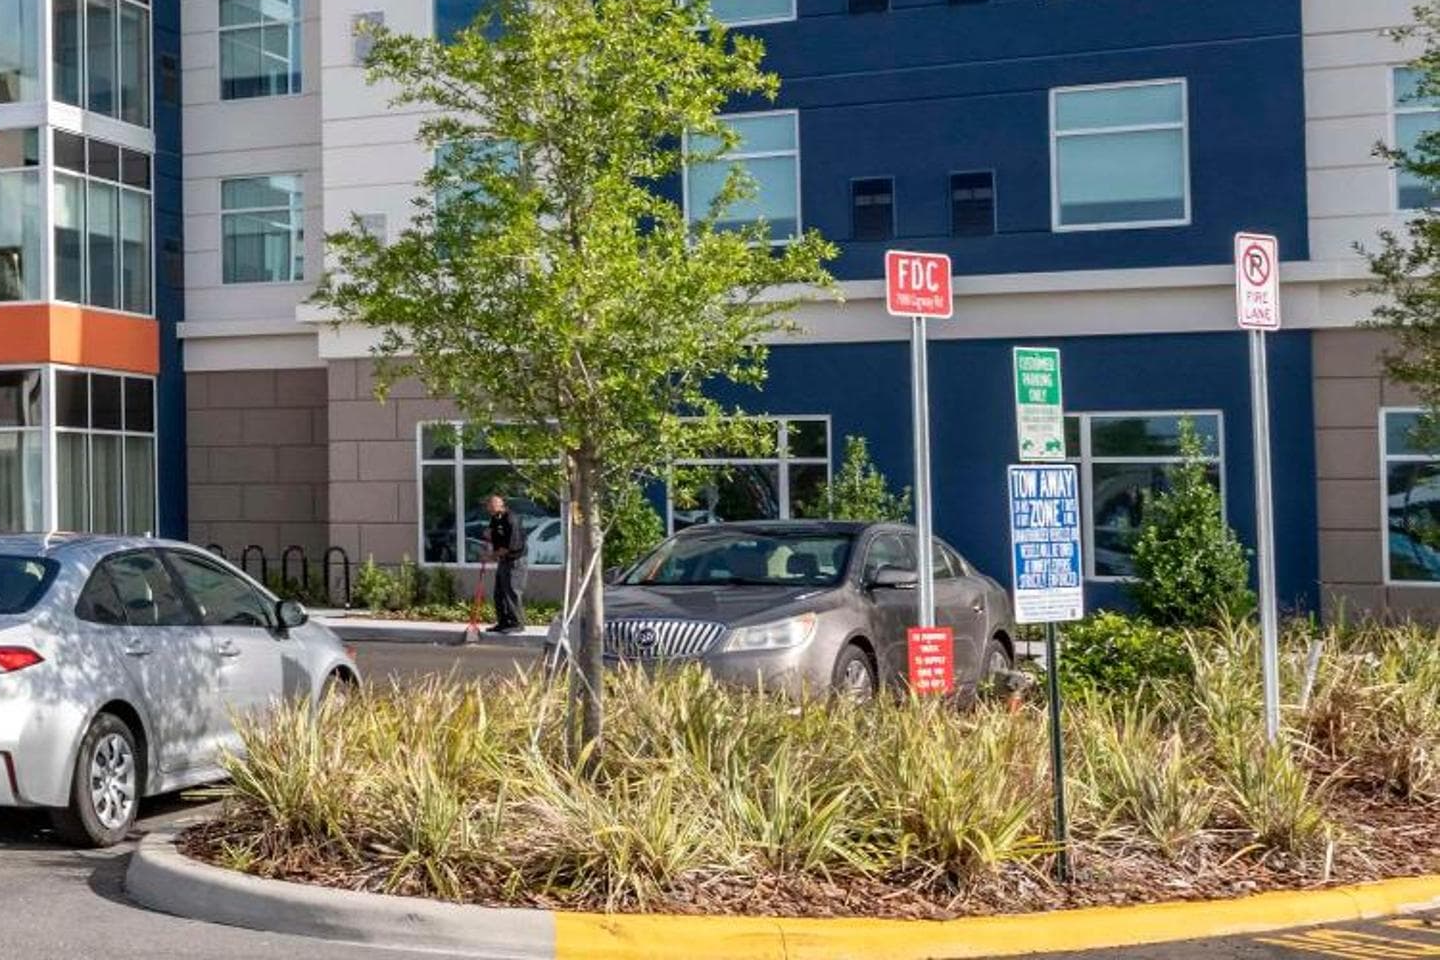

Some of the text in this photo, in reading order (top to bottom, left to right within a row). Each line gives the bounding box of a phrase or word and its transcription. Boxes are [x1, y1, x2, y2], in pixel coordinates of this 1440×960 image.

[897, 258, 940, 292] FDC
[1246, 291, 1269, 305] FIRE
[1245, 307, 1272, 322] LANE
[1011, 470, 1074, 499] TOW AWAY
[1030, 499, 1063, 528] ZONE
